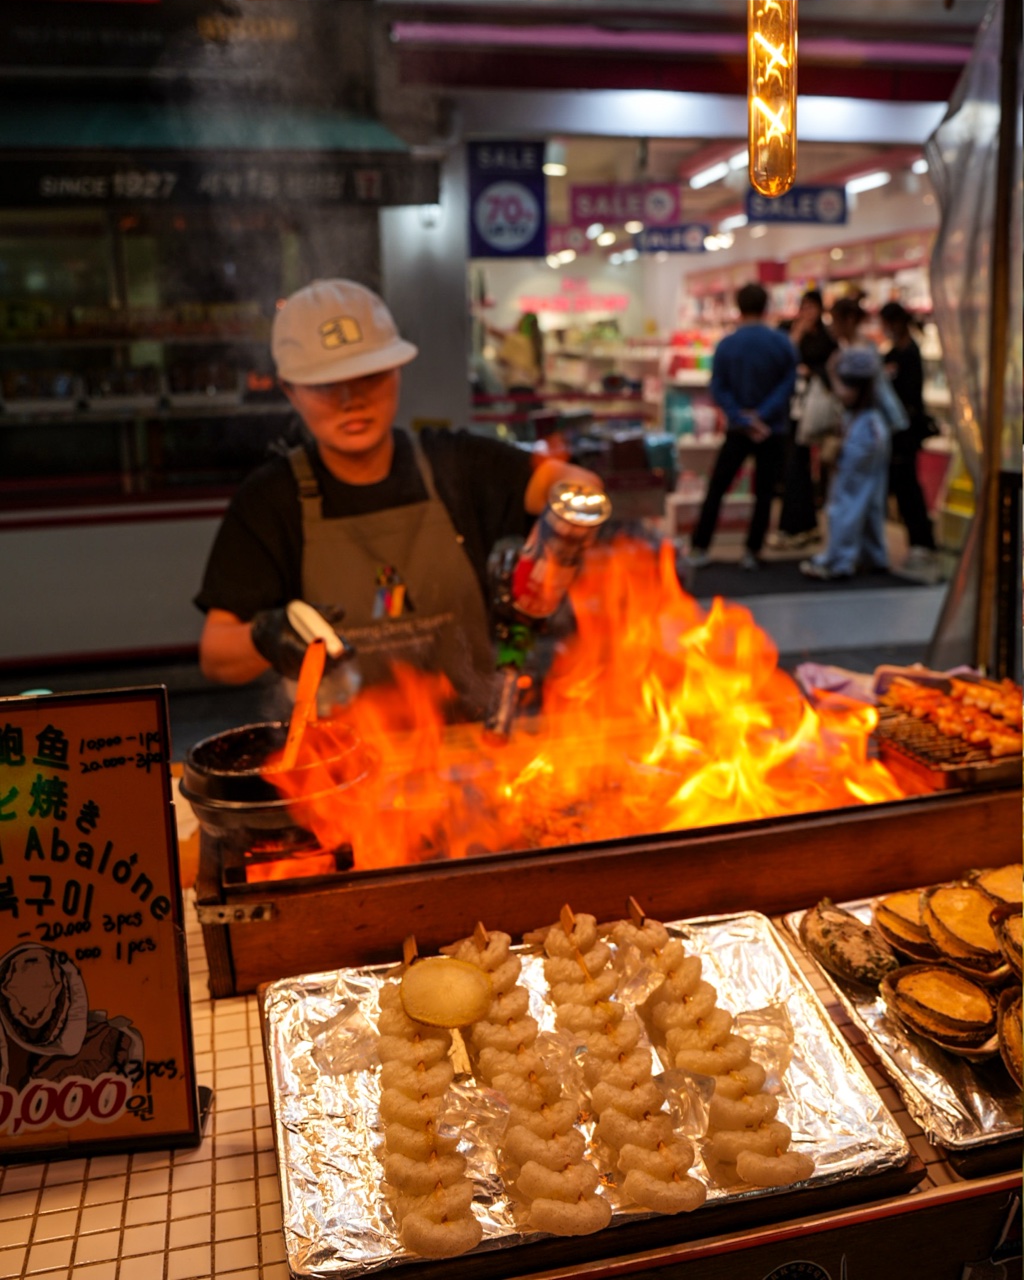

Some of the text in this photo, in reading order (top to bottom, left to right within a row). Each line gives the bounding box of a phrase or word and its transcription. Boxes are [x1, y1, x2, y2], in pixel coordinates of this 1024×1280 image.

[476, 147, 537, 168] SALE
[112, 171, 178, 198] 1927
[576, 193, 643, 217] SALE
[749, 195, 812, 216] SALE
